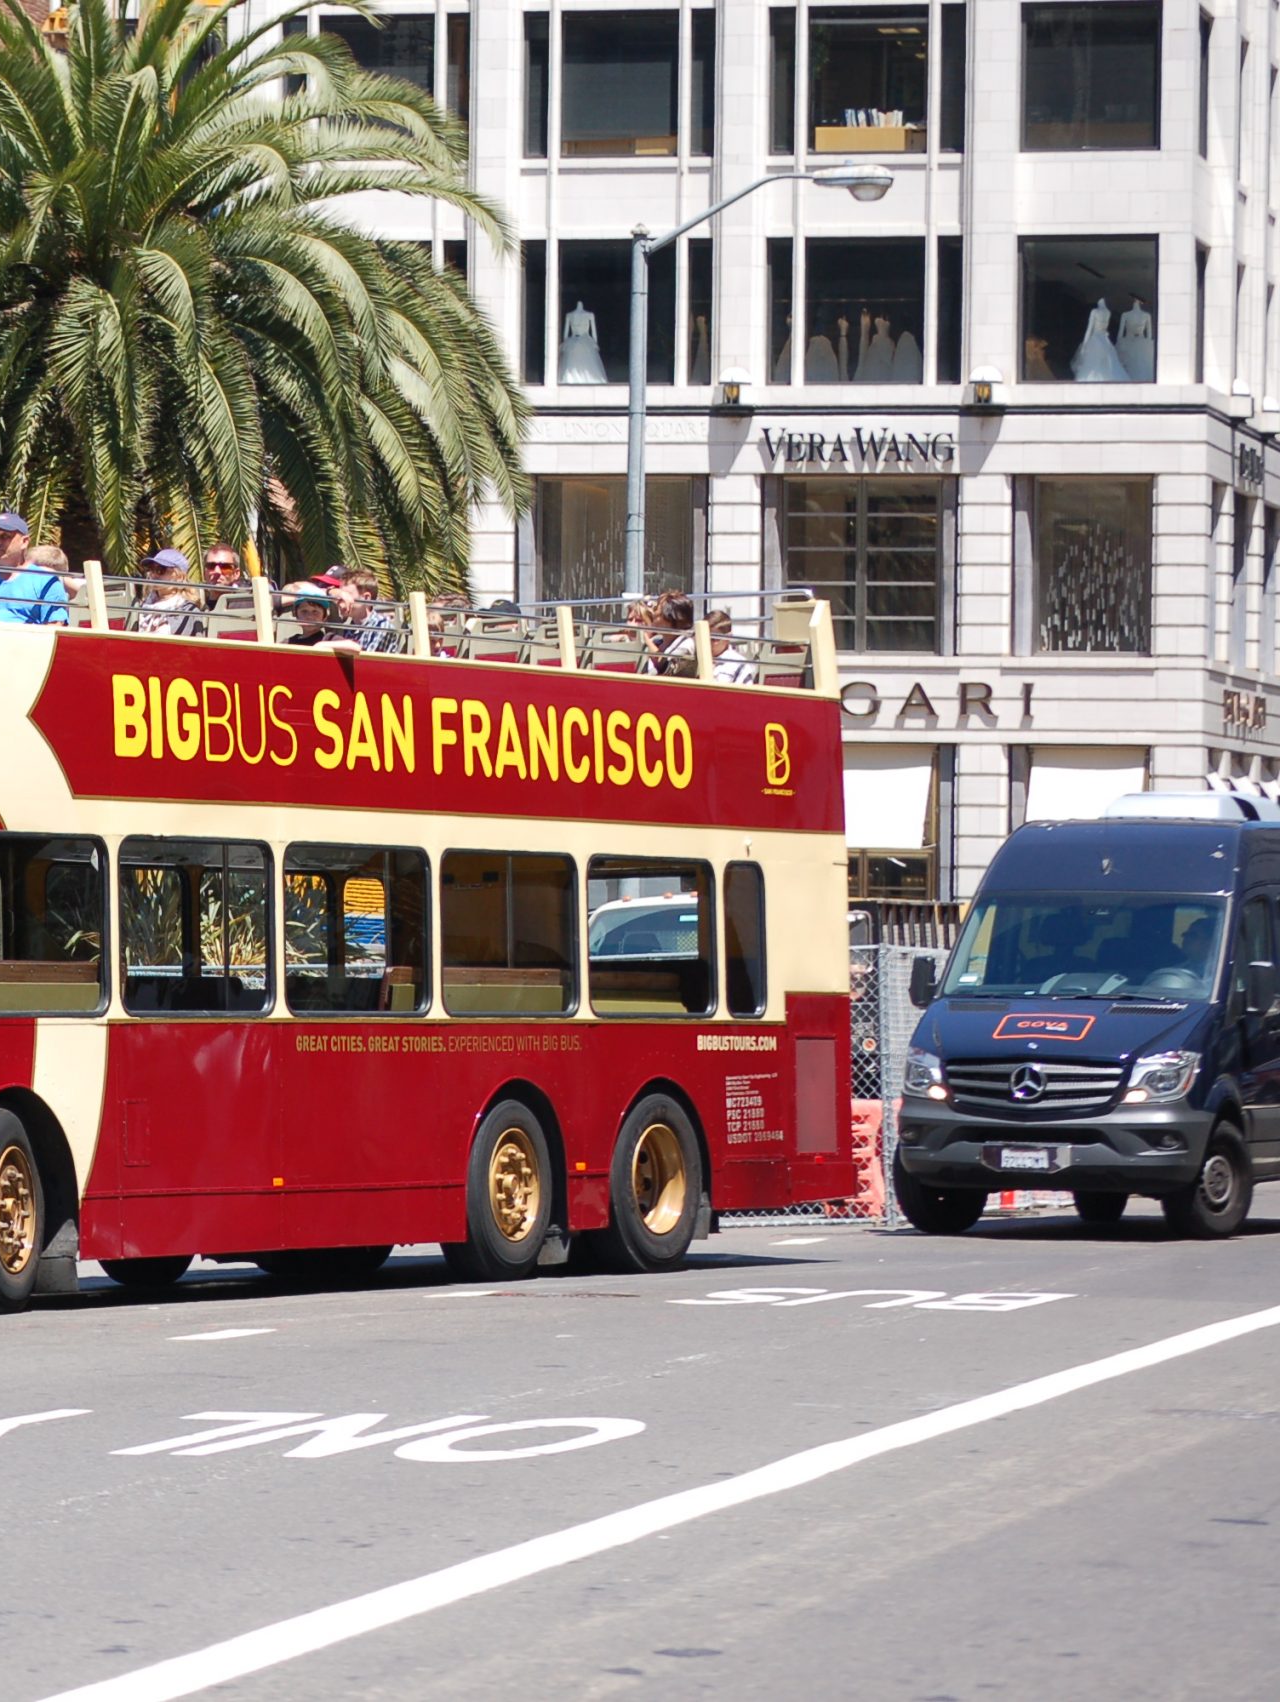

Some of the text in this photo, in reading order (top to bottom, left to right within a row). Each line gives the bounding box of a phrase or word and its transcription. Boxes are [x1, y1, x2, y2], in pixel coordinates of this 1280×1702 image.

[645, 421, 708, 438] QUARE
[761, 427, 956, 463] VERA WANG
[312, 688, 416, 774] SAN
[431, 697, 693, 789] FRANCISCO
[296, 1034, 583, 1052] GREAT CITIES. GREAT STORIES. EXPERIENCED WITH BIG BUS.
[697, 1034, 777, 1051] BIGBUSTOURS.COM
[726, 1109, 742, 1121] PSC
[726, 1121, 742, 1132] TCP
[666, 1287, 1078, 1312] BUS
